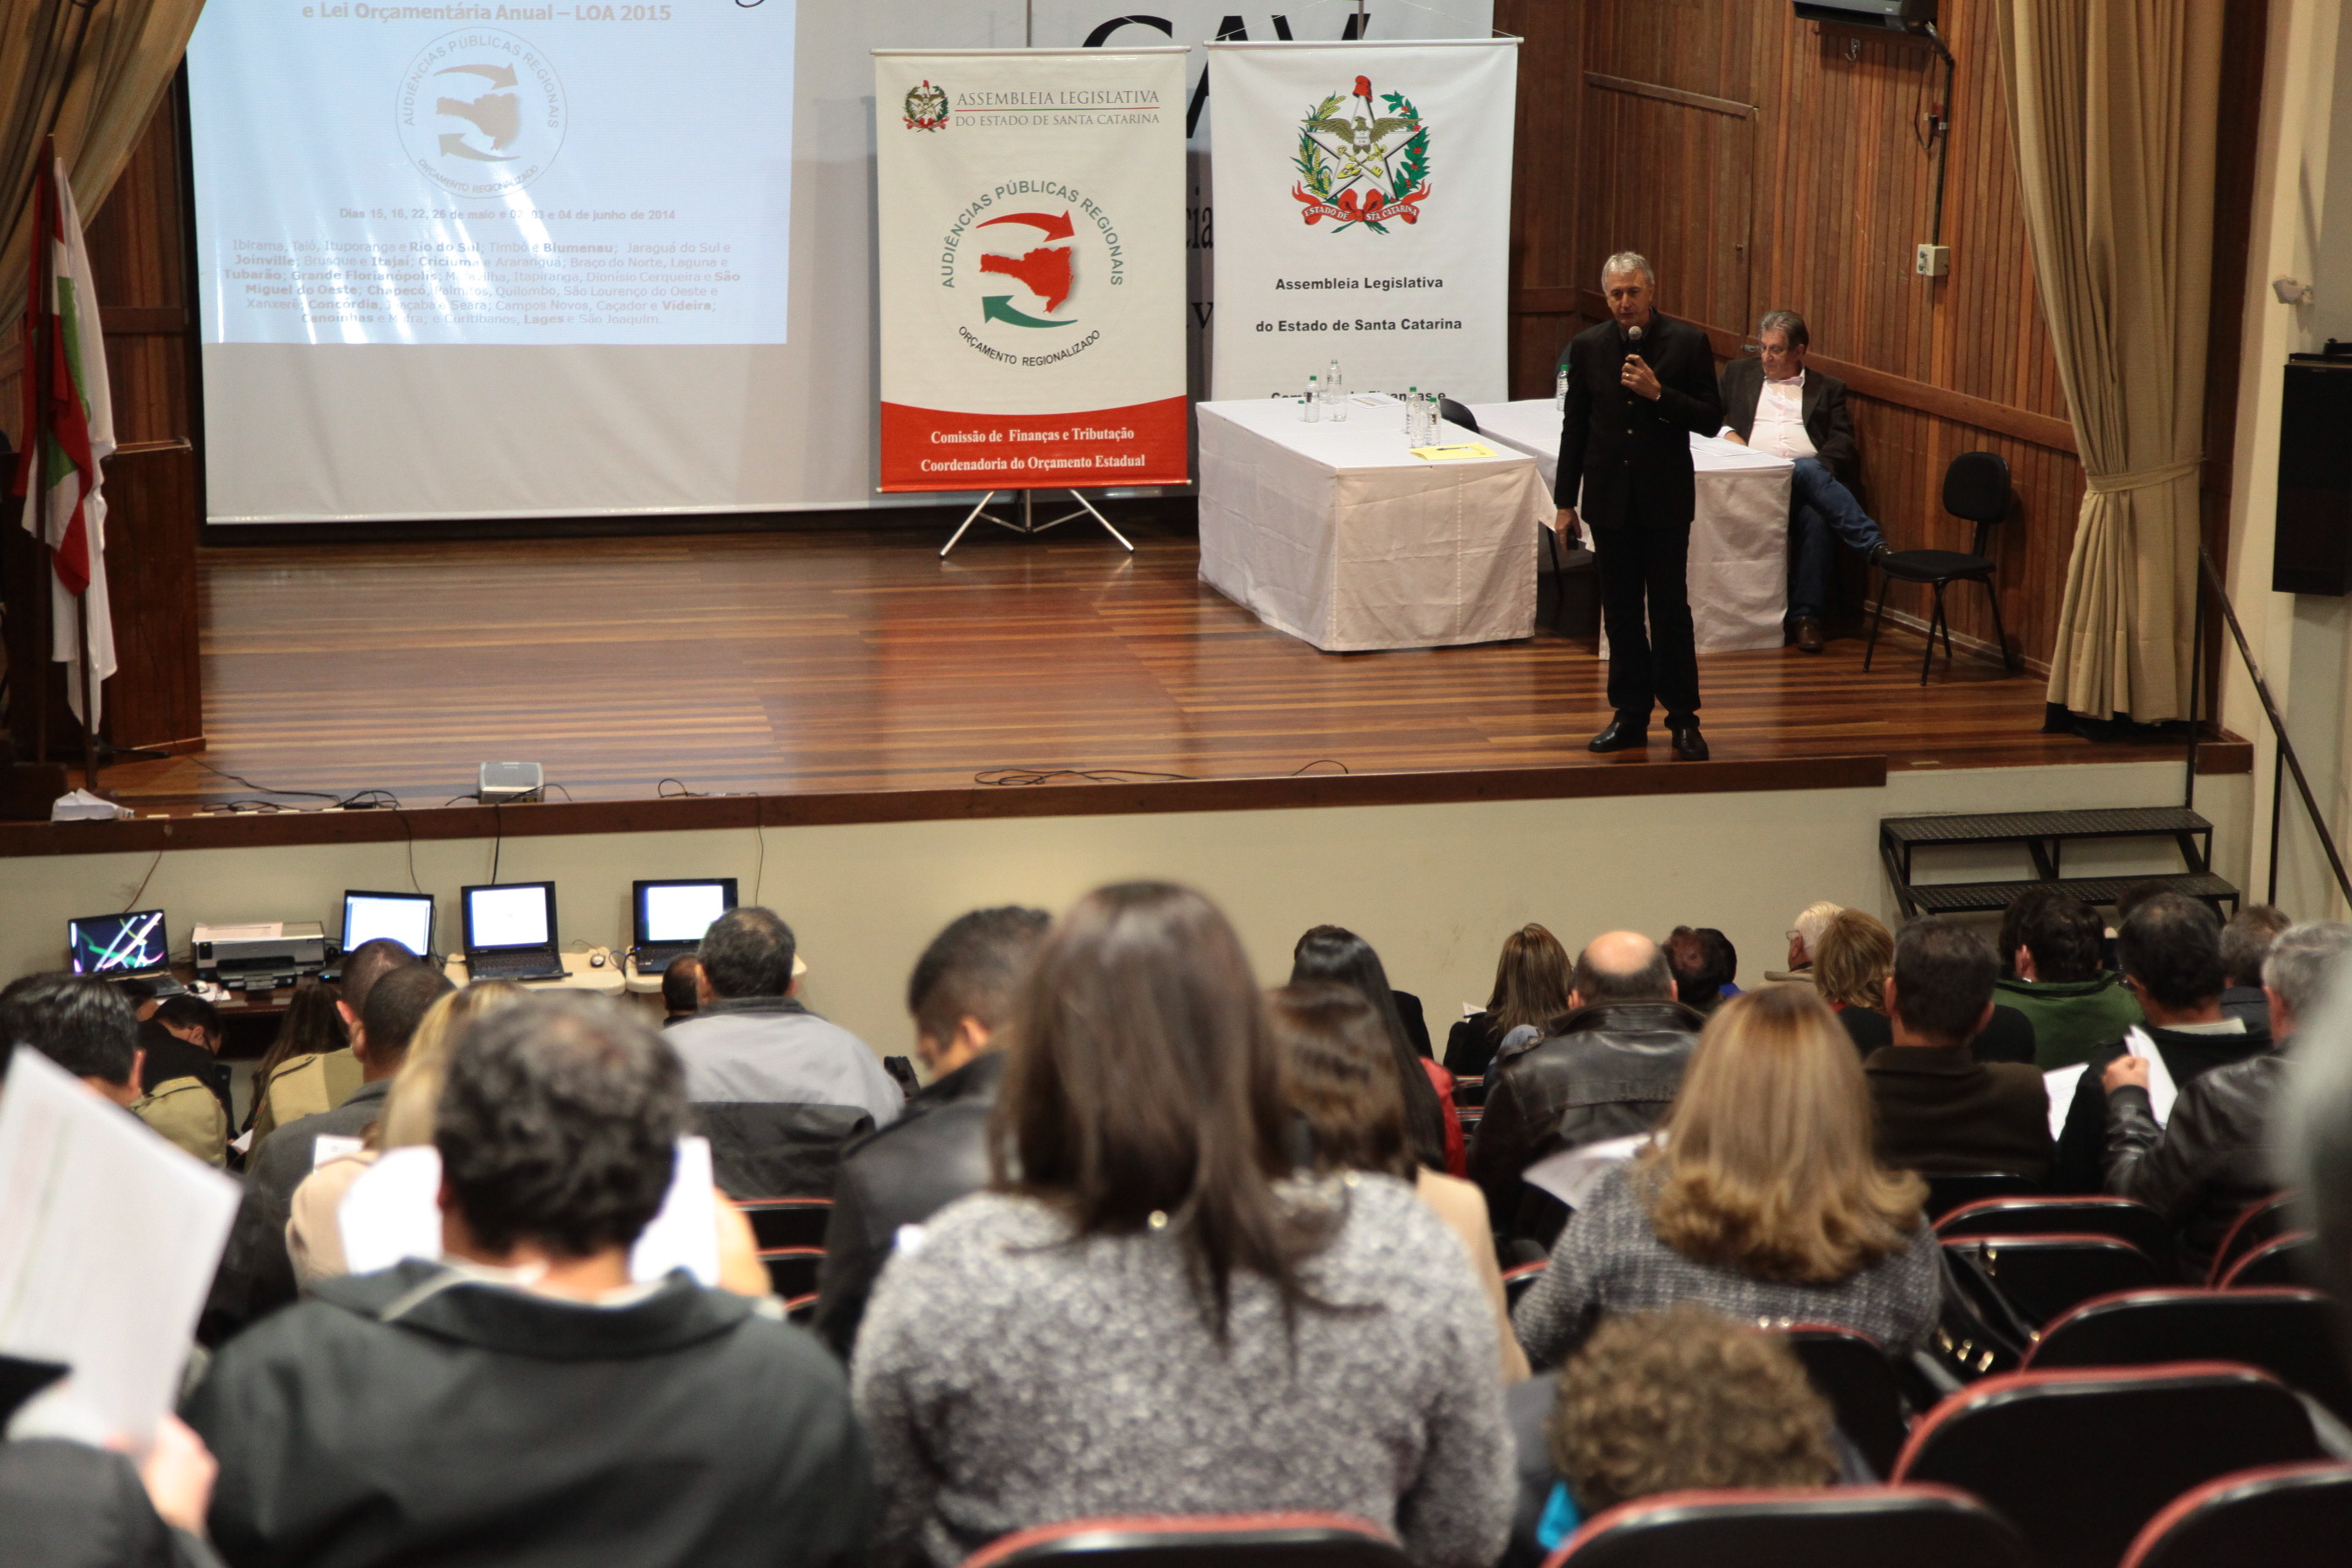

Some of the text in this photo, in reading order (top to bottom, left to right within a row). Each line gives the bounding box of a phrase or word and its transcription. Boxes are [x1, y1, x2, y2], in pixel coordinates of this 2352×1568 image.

[302, 7, 313, 18] e
[320, 3, 348, 19] Lei
[355, 3, 493, 23] Orçamentária
[496, 5, 553, 19] Anual
[575, 6, 615, 20] LOA
[621, 6, 672, 20] 2015
[404, 34, 560, 129] AUDIÊNCIAS PÚBLICAS REGIONAIS
[957, 90, 1160, 106] ASSEMBLEIA LEGISLATIVA
[956, 115, 976, 127] DO
[979, 114, 1029, 127] ESTADO
[1032, 115, 1049, 126] DE
[1054, 114, 1094, 126] SANTA
[1097, 113, 1160, 125] CATARINA
[340, 209, 365, 219] Dias
[371, 209, 387, 220] 15,
[391, 209, 408, 220] 16,
[411, 209, 428, 220] 22,
[433, 209, 446, 219] 26
[449, 209, 464, 220] de
[467, 210, 495, 220] maio
[499, 211, 507, 220] e
[548, 211, 555, 220] e
[558, 210, 572, 220] 04
[575, 210, 589, 220] de
[592, 210, 626, 222] junho
[631, 210, 645, 220] de
[648, 210, 676, 220] 2014
[1304, 206, 1337, 217] ESTADO
[1337, 210, 1349, 220] DE
[941, 179, 1124, 288] AUDIÊNCIAS PÚBLICAS REGIONAIS
[324, 240, 395, 253] Ituporanga
[399, 242, 406, 251] e
[410, 241, 433, 252] Rio
[436, 242, 453, 252] do
[489, 242, 528, 253] Timbó
[543, 242, 618, 255] Blumenau;
[627, 242, 676, 256] Jaraguá
[680, 243, 694, 253] do
[700, 243, 720, 253] Sul
[723, 245, 731, 253] e
[360, 258, 368, 266] e
[570, 258, 606, 270] Braço
[608, 258, 623, 268] do
[628, 258, 667, 270] Norte,
[671, 258, 717, 270] Laguna
[720, 260, 728, 269] e
[291, 270, 341, 280] Grande
[587, 270, 636, 282] Dionísio
[640, 272, 701, 286] Cerqueira
[714, 270, 741, 282] São
[1276, 276, 1443, 291] Assembleia Legislativa
[246, 284, 293, 297] Miguel
[297, 285, 315, 295] do
[496, 286, 560, 298] Quilombo,
[564, 285, 587, 297] São
[591, 286, 645, 299] Lourenço
[651, 286, 667, 297] do
[670, 286, 706, 297] Oeste
[385, 300, 436, 313] Jaçaba
[496, 300, 547, 312] Campos
[596, 300, 647, 313] Caçador
[650, 302, 657, 311] e
[302, 313, 373, 324] Canoinhas
[378, 315, 385, 324] e
[389, 313, 427, 325] Mfra;
[433, 315, 440, 324] e
[525, 313, 564, 326] Lages
[579, 313, 602, 324] São
[1256, 318, 1462, 332] do Estado de Santa Catarina
[958, 326, 1100, 367] ORÇAMENTO REGIONALIZADO
[931, 427, 1135, 444] Comissão de Finanças e Tributação
[921, 454, 1146, 472] Coordenadoria do Orçamento Estadual
